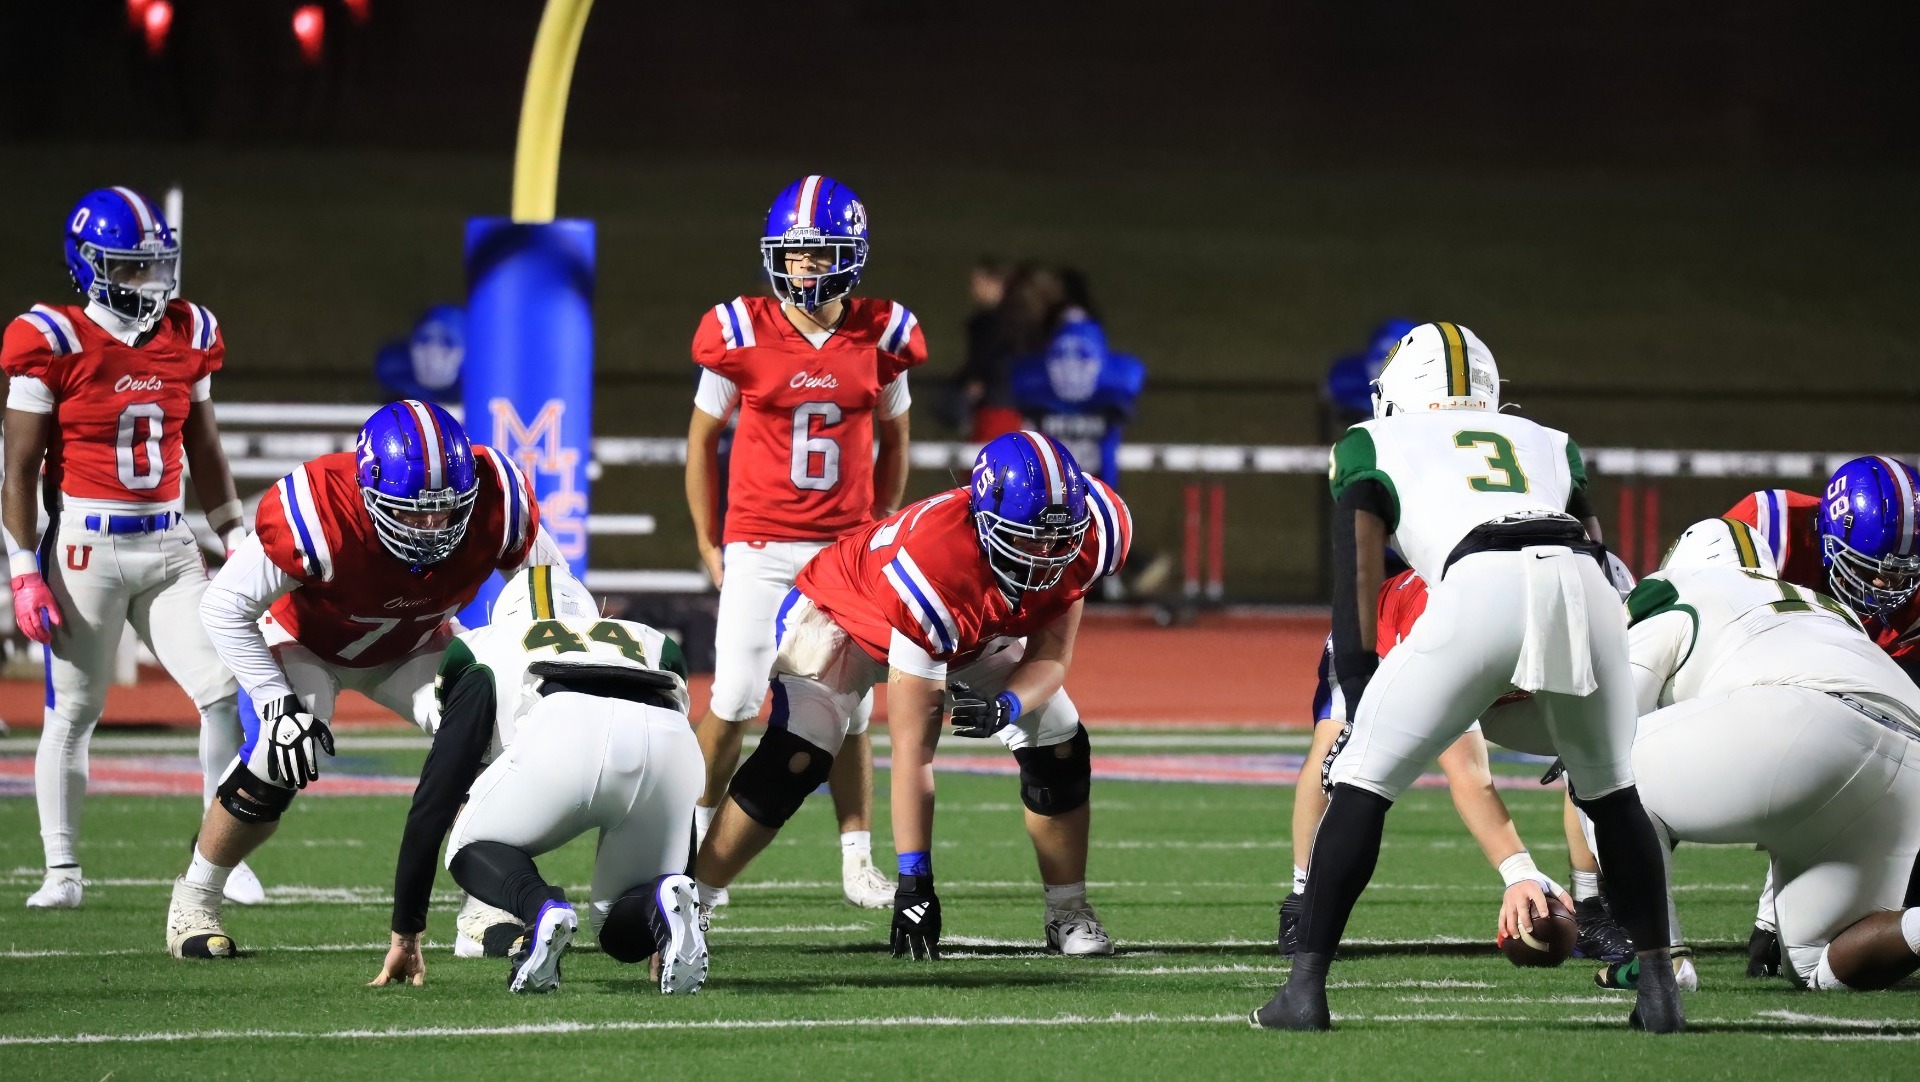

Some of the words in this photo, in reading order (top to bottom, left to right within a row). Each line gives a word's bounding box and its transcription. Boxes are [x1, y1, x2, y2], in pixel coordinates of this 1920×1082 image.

[114, 374, 163, 393] Owls
[789, 371, 839, 389] Owls
[116, 401, 165, 491] 0
[790, 401, 842, 491] 6
[1452, 429, 1530, 494] 3
[972, 452, 997, 498] 75
[1826, 474, 1850, 521] 58
[66, 544, 93, 571] U
[521, 620, 649, 669] 44
